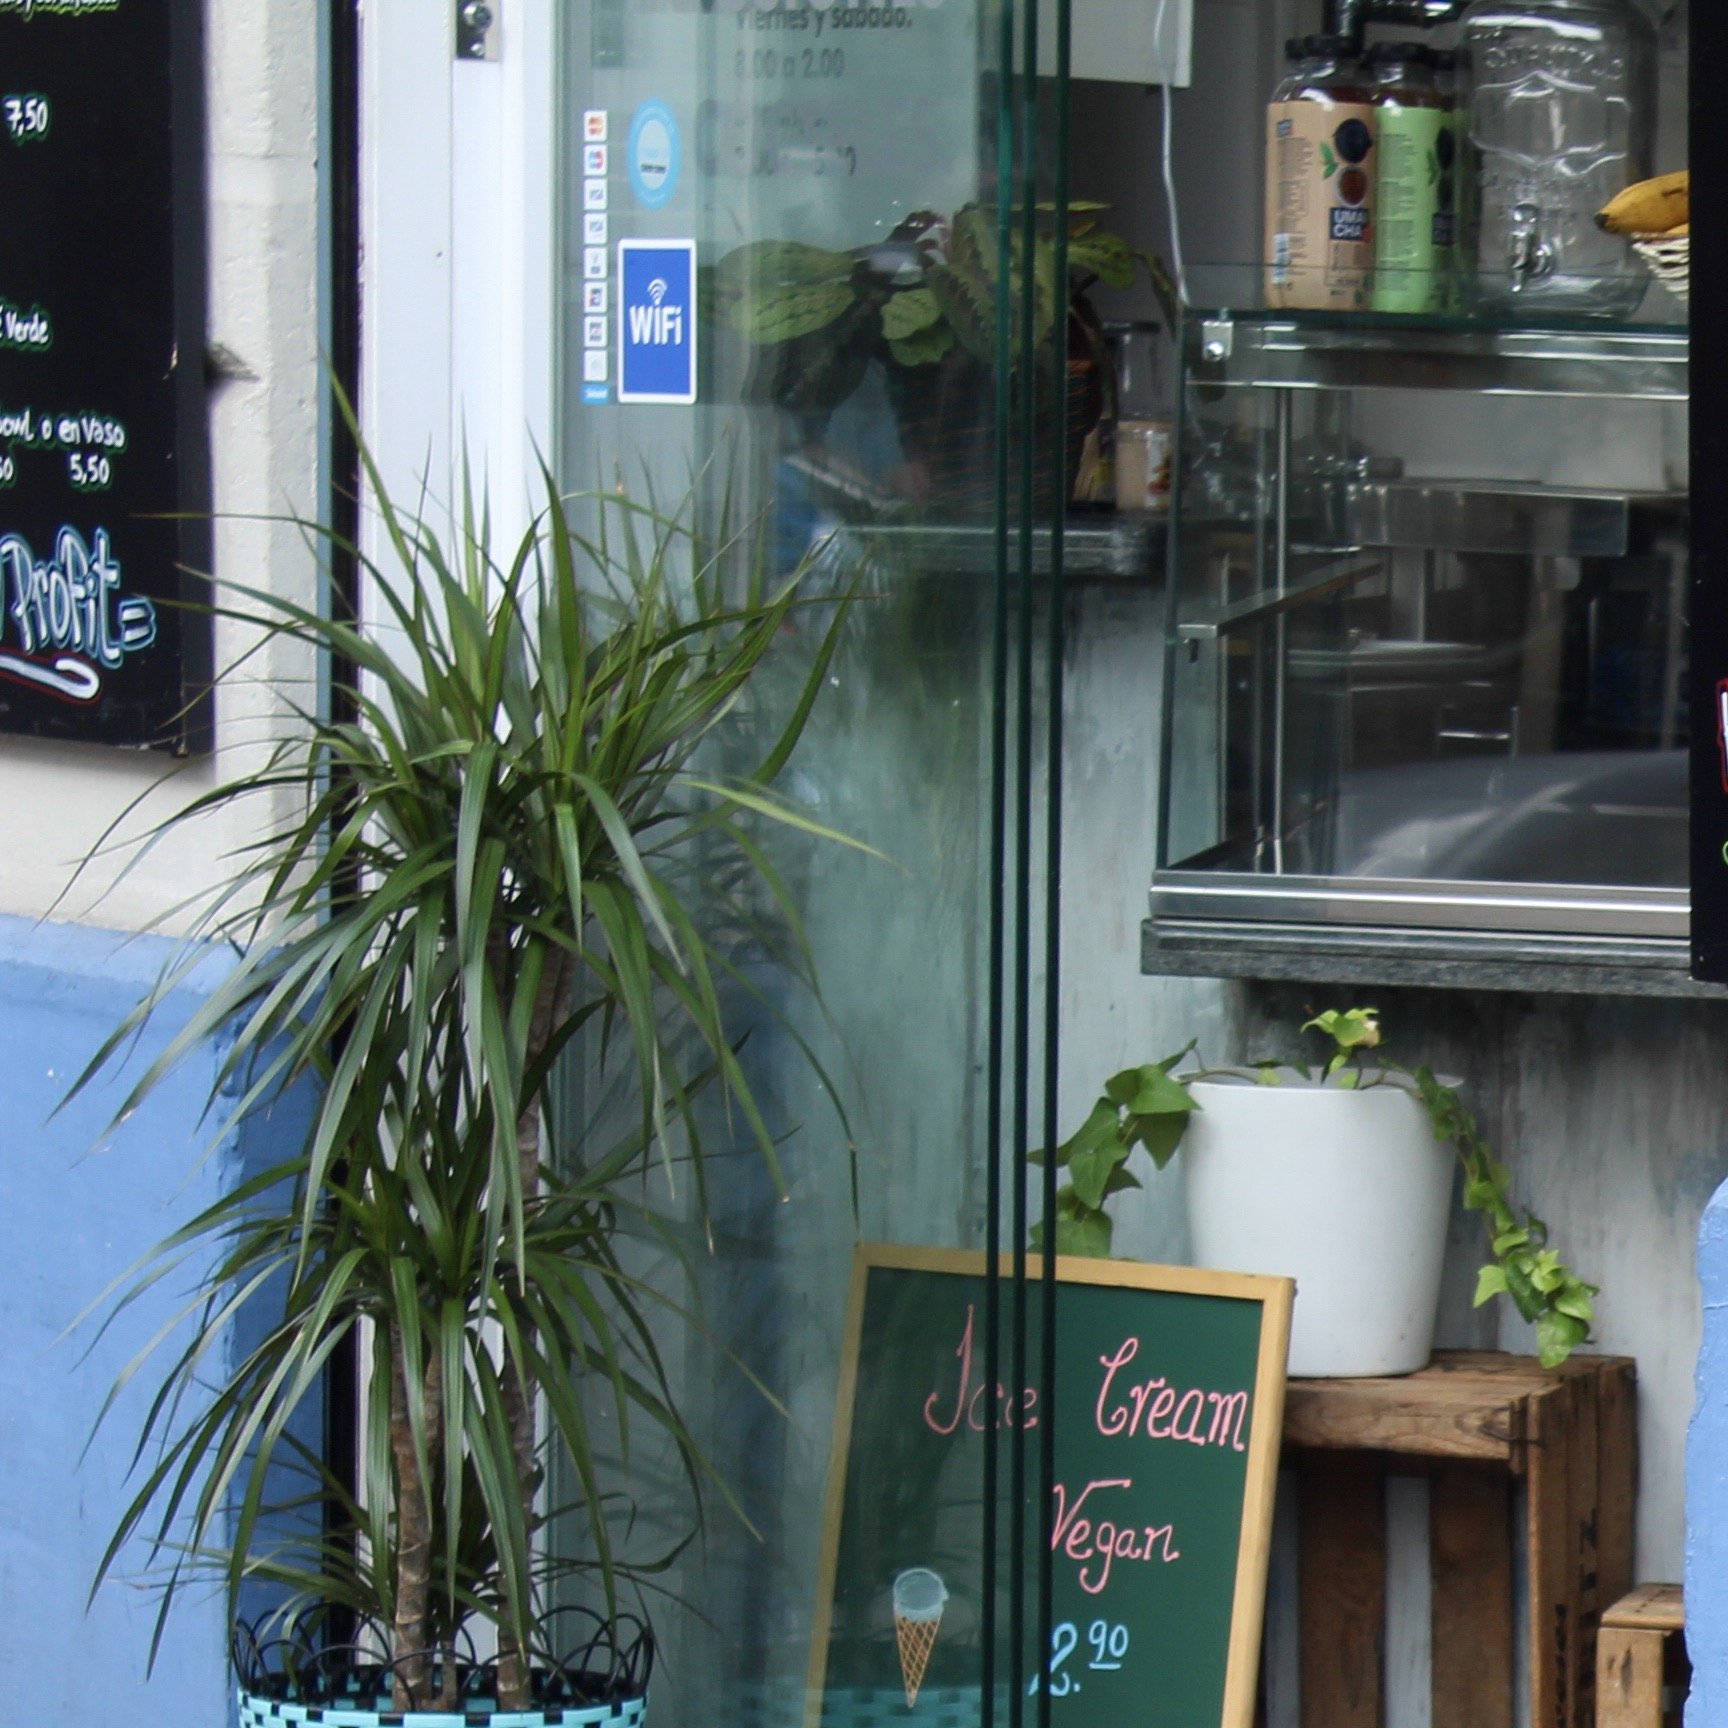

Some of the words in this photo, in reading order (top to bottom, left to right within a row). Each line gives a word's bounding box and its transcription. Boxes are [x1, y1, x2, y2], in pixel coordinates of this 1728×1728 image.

[4, 98, 49, 137] 7,50
[5, 310, 50, 344] Verde
[69, 452, 111, 485] 5,50
[1095, 1337, 1248, 1452] Cream
[1050, 1479, 1180, 1594] Vegan
